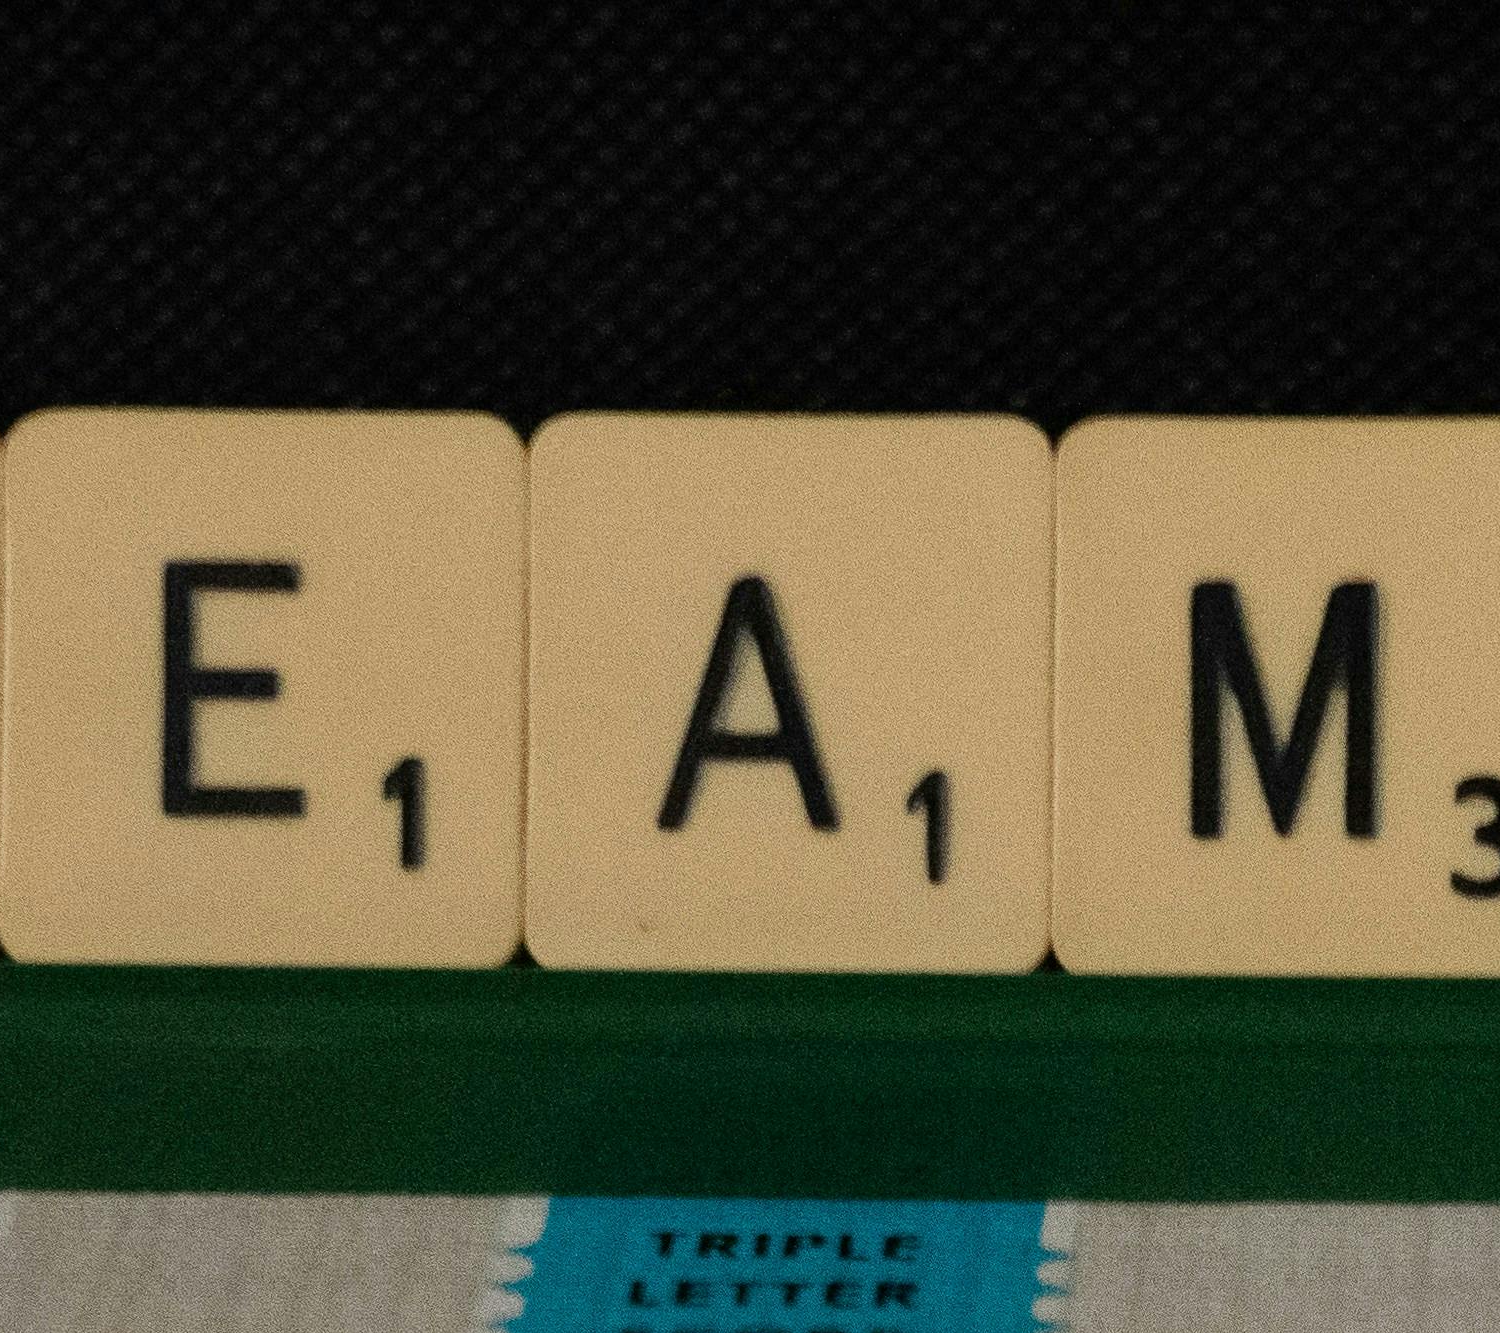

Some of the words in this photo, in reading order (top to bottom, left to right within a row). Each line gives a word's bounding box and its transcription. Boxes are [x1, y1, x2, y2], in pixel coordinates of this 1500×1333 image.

[380, 754, 429, 873] 1
[903, 767, 953, 887] 1
[650, 1230, 920, 1261] TRIPLE
[626, 1280, 920, 1308] LETTER
